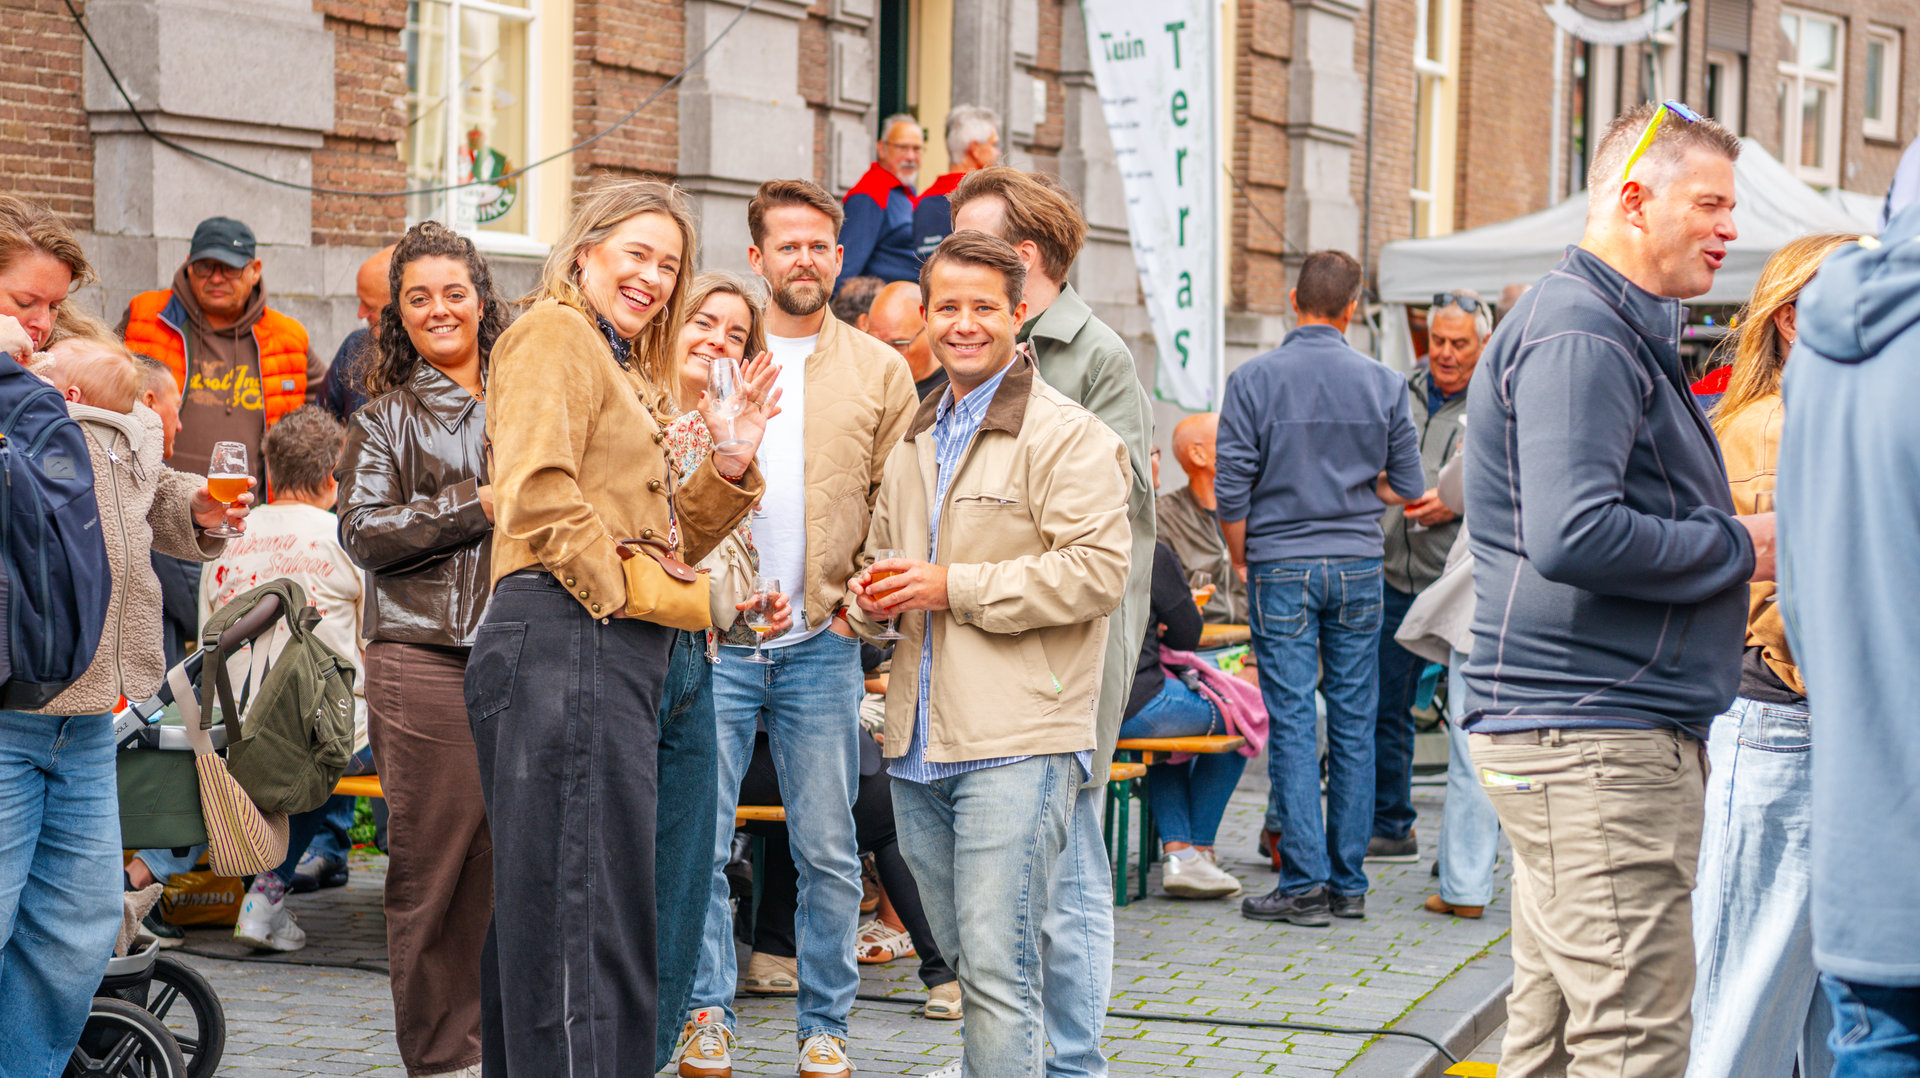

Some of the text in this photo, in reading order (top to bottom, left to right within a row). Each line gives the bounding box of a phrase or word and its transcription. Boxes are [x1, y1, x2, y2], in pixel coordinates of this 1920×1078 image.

[1099, 30, 1145, 62] Tuin
[1164, 20, 1192, 370] Terras
[261, 552, 335, 578] Saloon
[171, 891, 235, 906] JUMBO
